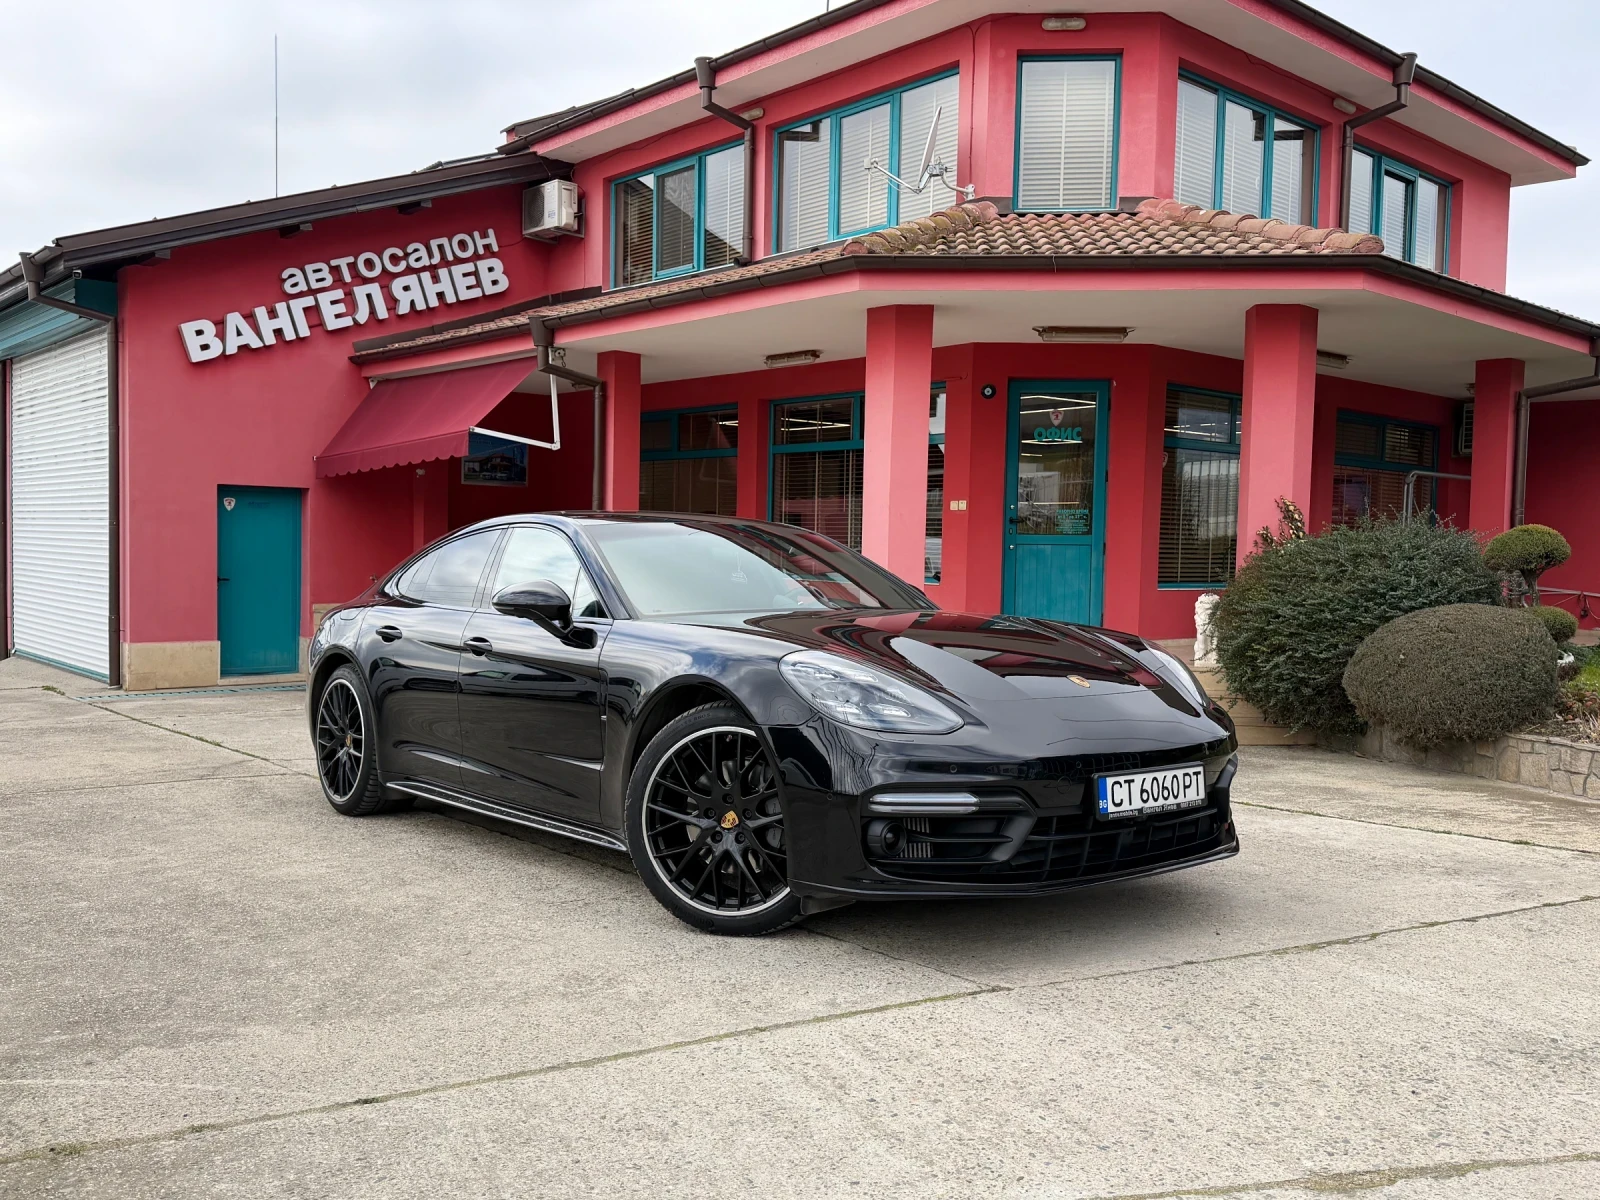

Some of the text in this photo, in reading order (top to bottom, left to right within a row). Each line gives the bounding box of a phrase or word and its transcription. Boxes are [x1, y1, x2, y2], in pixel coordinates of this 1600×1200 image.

[281, 228, 499, 294] автосалон
[178, 258, 509, 363] ВАНГЕЛ ЯНЕВ
[1034, 427, 1082, 441] ОФИС
